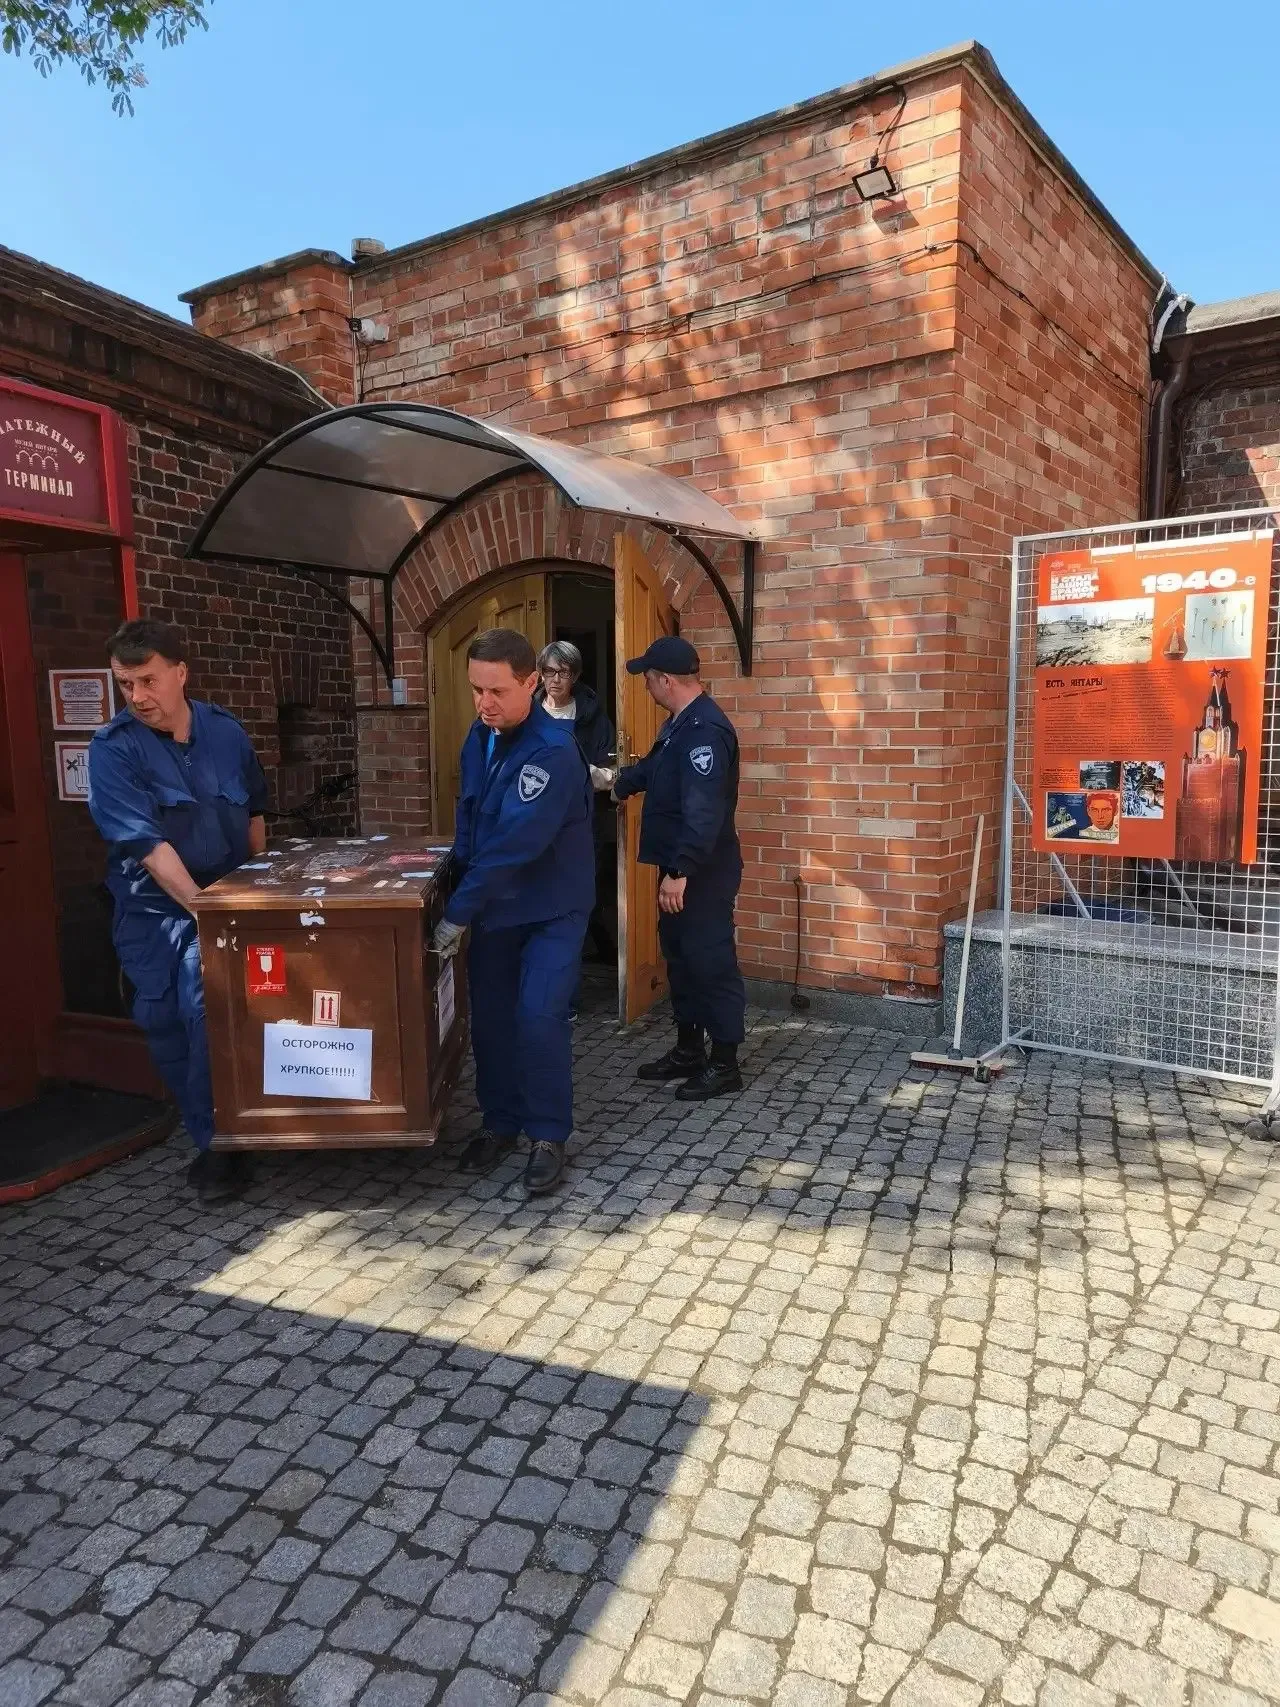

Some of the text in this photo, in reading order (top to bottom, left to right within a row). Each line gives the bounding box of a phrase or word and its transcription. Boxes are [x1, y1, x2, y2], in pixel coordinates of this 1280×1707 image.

[5, 468, 73, 497] ТЕРМИНАЛ
[1046, 680, 1065, 688] ЕСТЬ
[282, 1038, 355, 1051] ОСТОРОЖНО
[280, 1064, 355, 1077] ХРУПКОЕ!!!!!!
